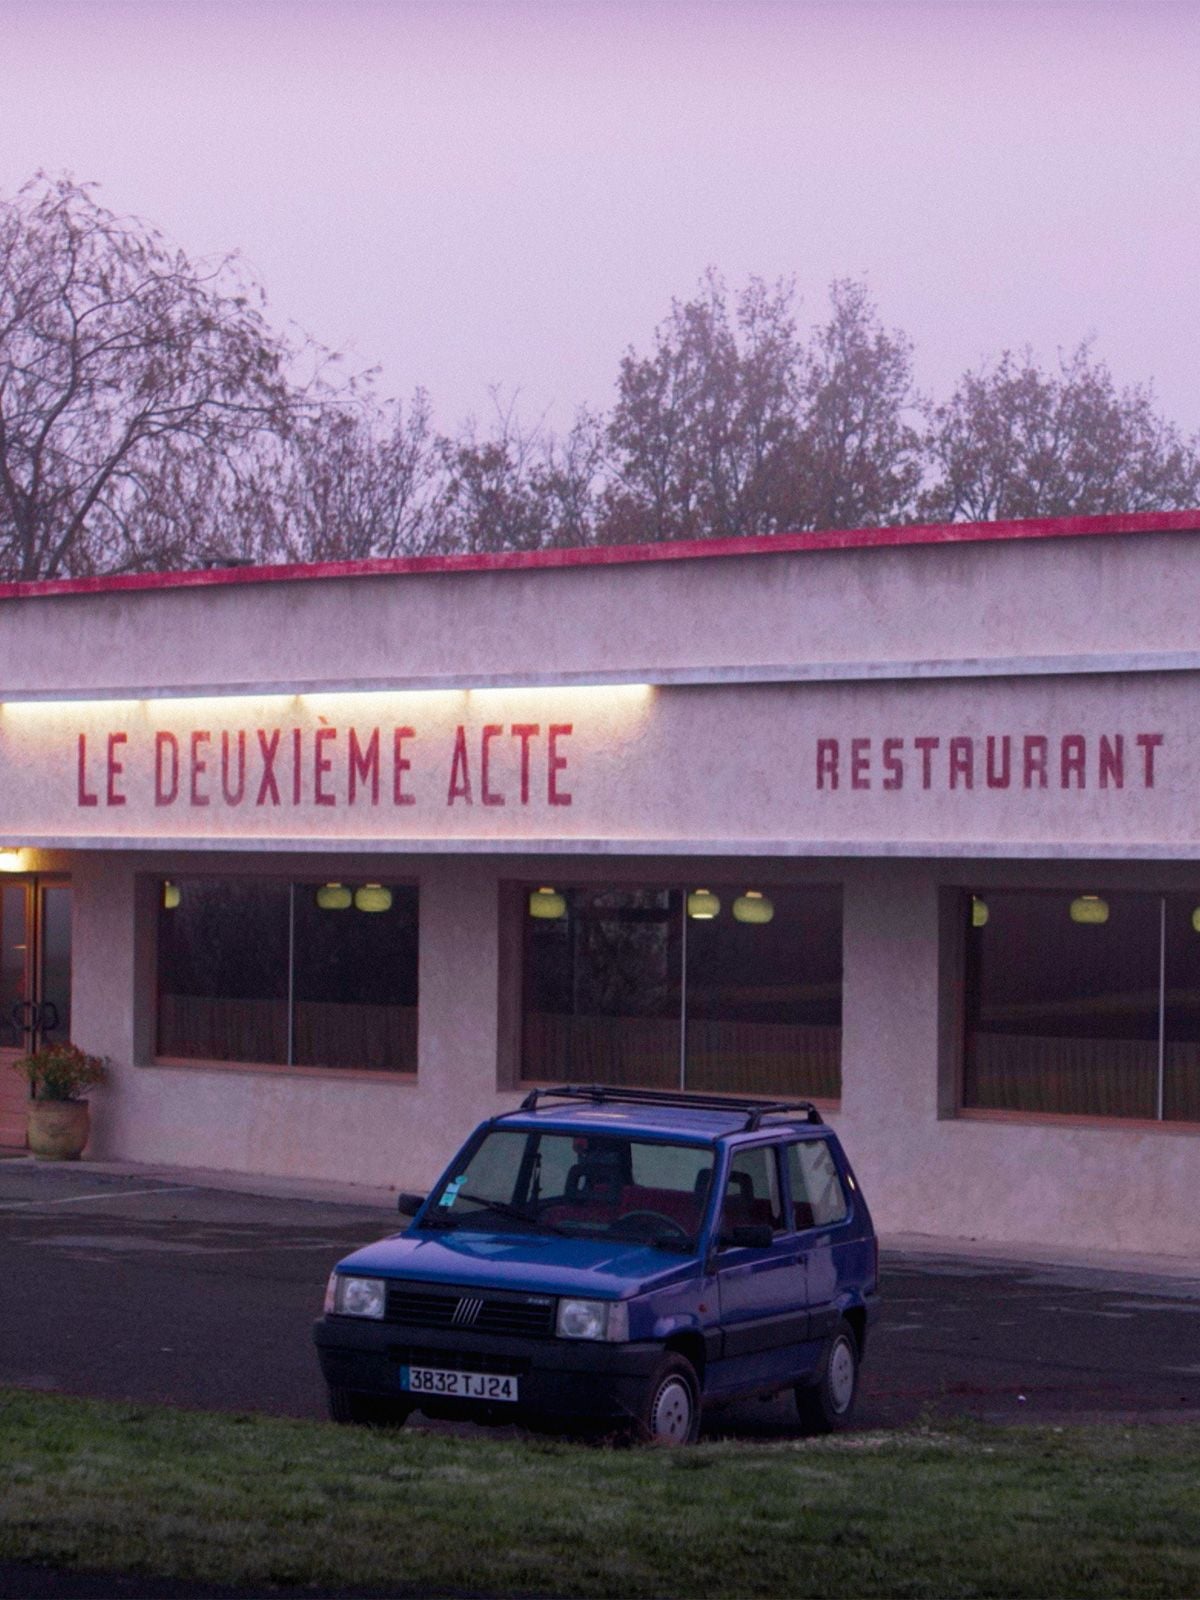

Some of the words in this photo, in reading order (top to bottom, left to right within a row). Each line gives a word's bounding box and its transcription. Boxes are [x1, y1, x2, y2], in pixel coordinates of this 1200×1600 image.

[77, 732, 128, 807] LE
[154, 716, 416, 806] DEUXIÈME
[447, 723, 573, 806] ACTE
[816, 733, 1163, 790] RESTAURANT
